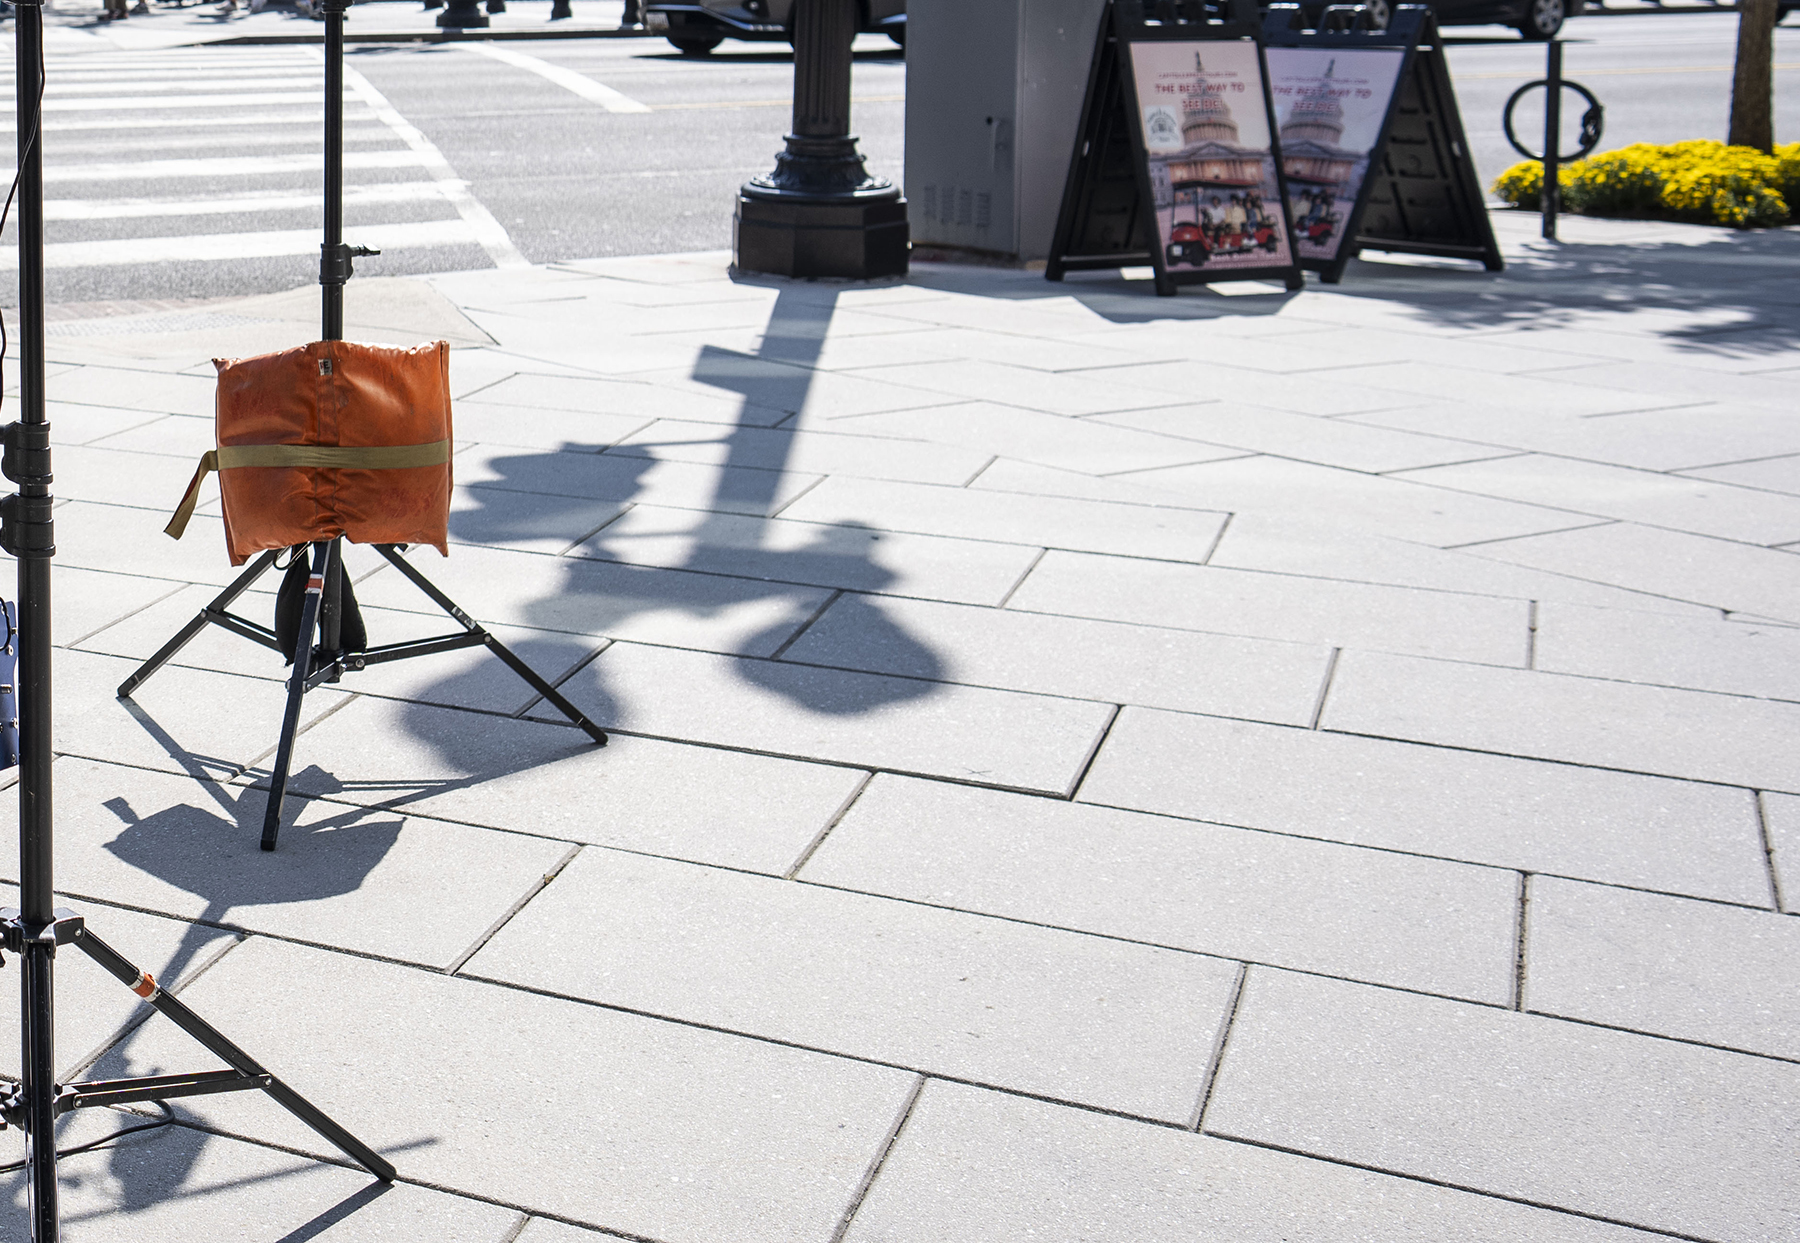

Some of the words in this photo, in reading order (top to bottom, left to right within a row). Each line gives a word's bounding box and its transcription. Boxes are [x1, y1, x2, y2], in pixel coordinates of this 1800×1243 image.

[1155, 83, 1175, 94] THE
[1178, 83, 1202, 94] BEST
[1206, 82, 1228, 93] WAY
[1231, 82, 1245, 93] TO
[1273, 86, 1293, 96] THE
[1296, 86, 1324, 96] BEST
[1327, 88, 1352, 97] WAY
[1355, 88, 1372, 99] TO
[1182, 99, 1200, 111] SEE
[1293, 100, 1314, 111] SEE
